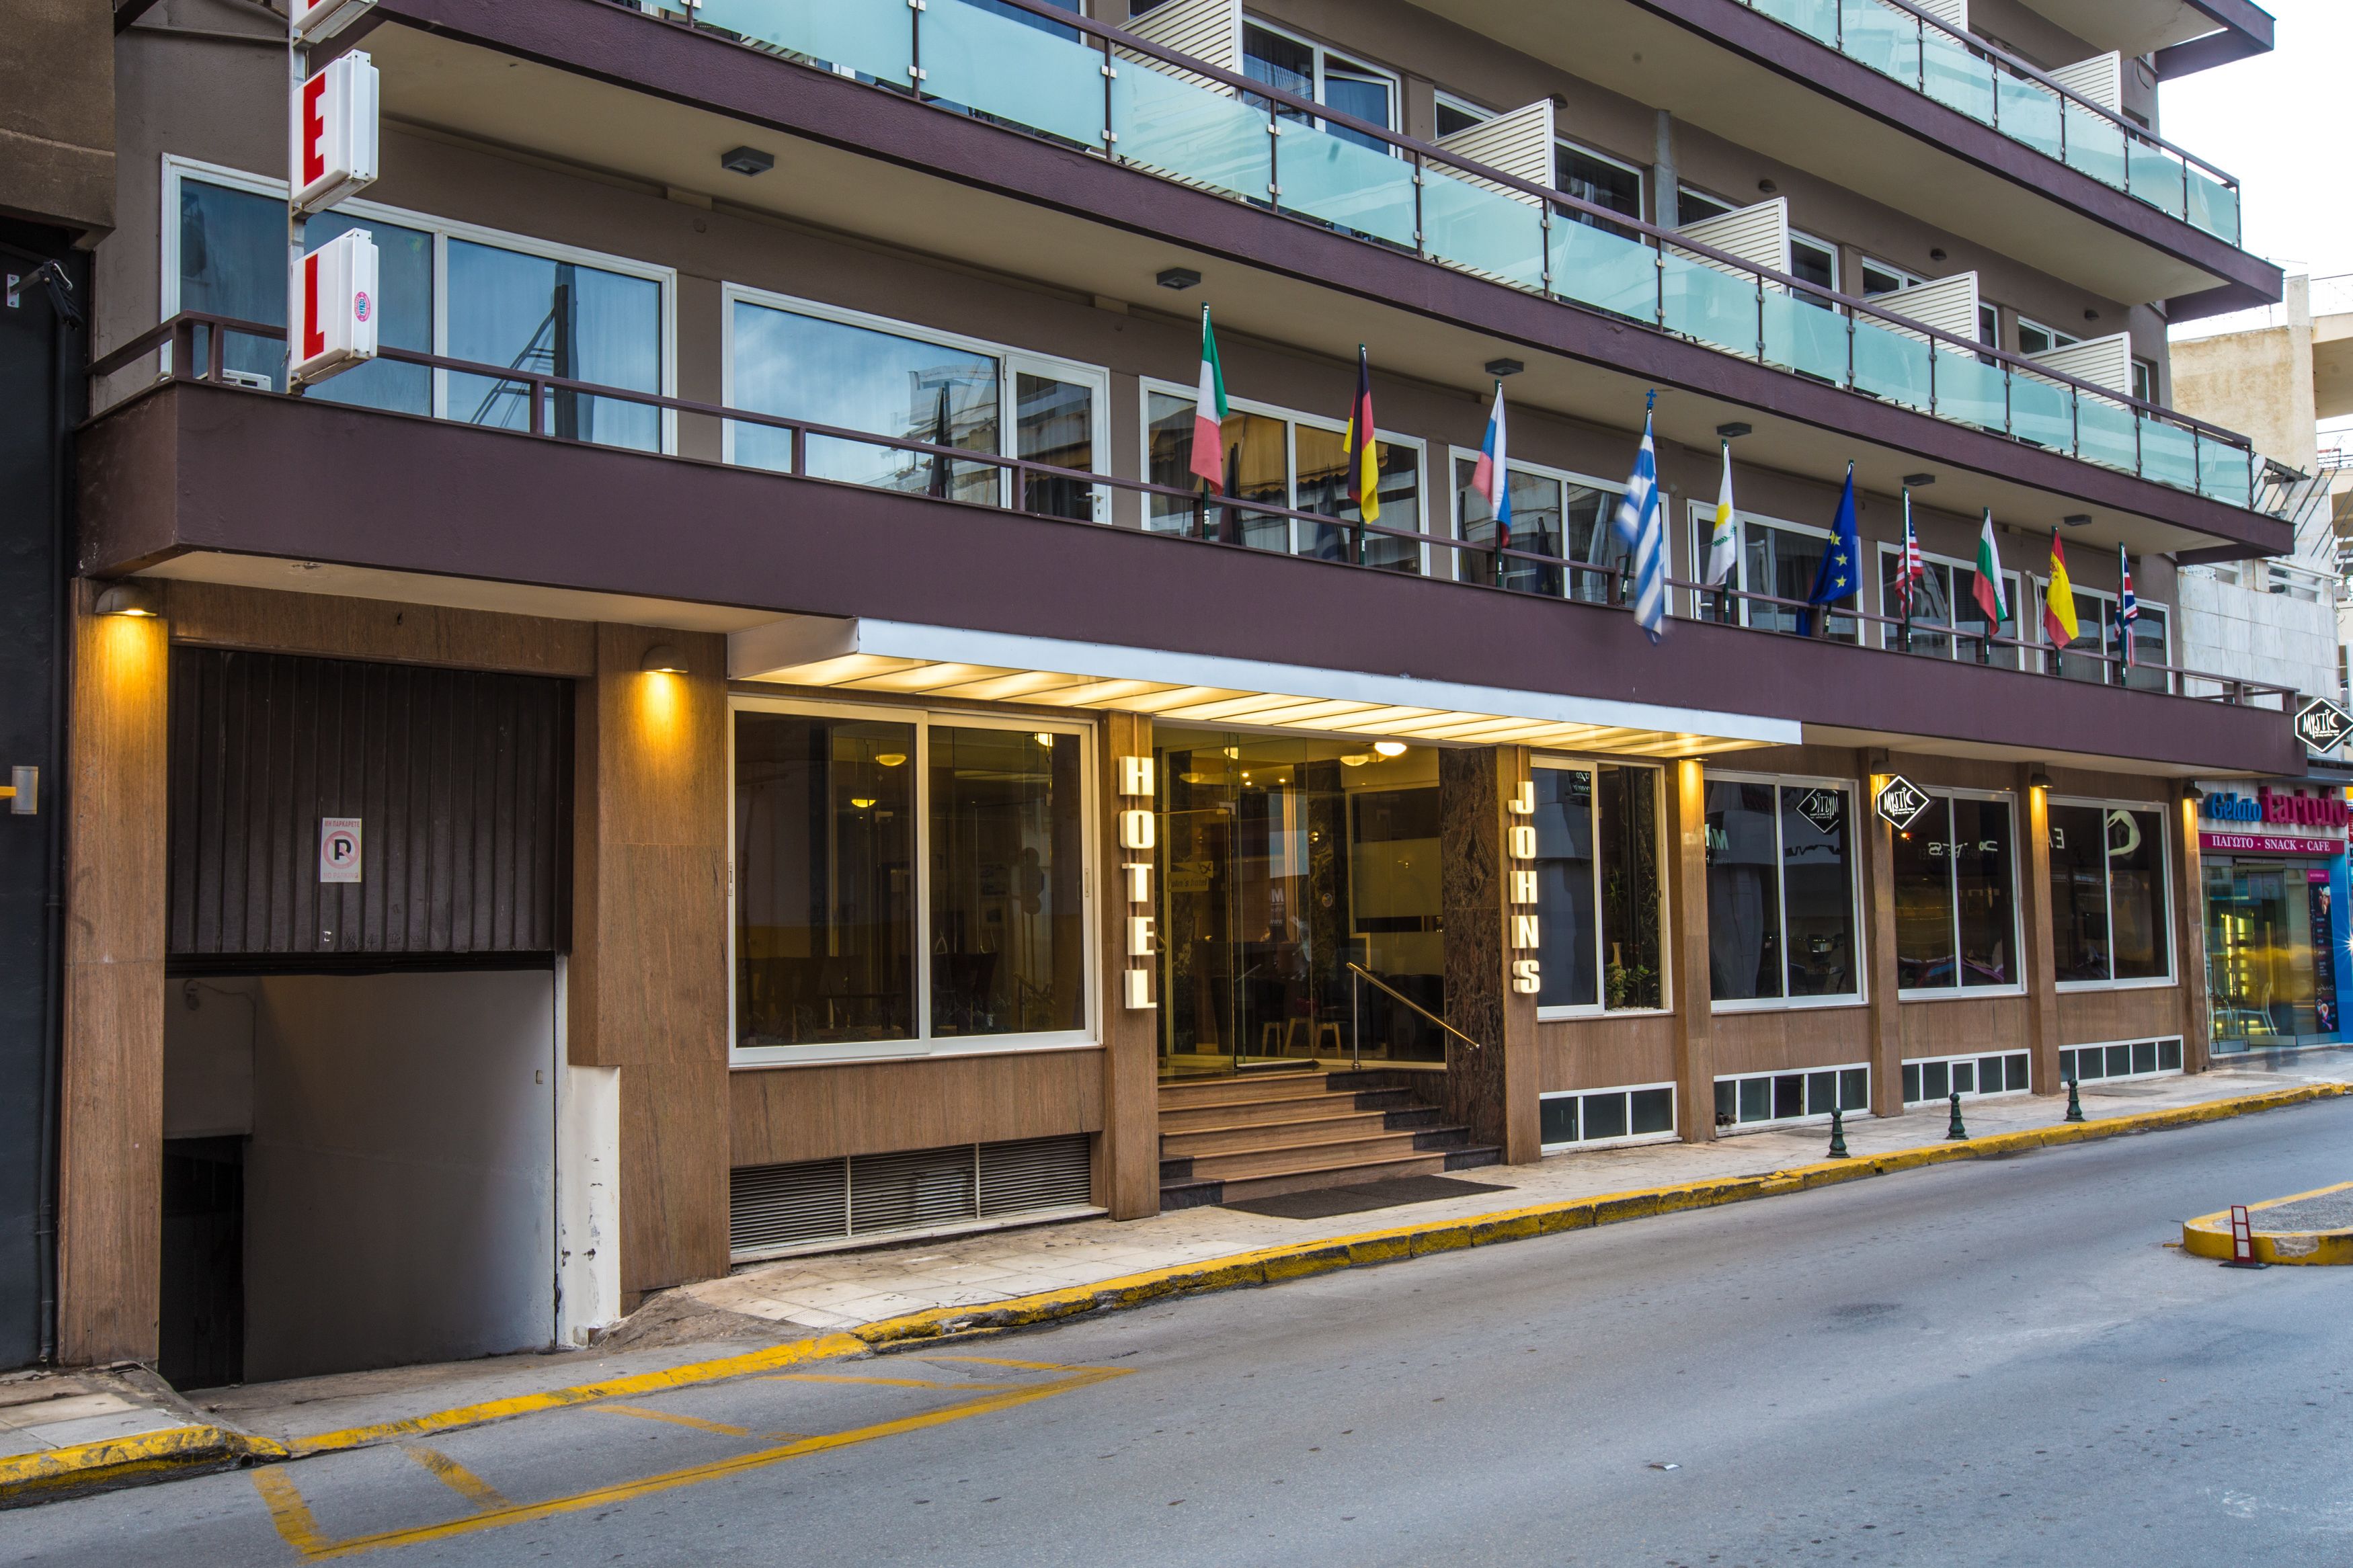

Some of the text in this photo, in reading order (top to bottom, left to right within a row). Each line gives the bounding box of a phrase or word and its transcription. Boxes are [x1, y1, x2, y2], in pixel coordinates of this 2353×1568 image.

[2204, 785, 2348, 828] Gelato tartufo
[2212, 835, 2254, 848] ΠΑΓΩΤΟ
[2265, 839, 2297, 851] SNACK
[2307, 840, 2331, 852] CAFE
[1119, 756, 1157, 1009] HOTEL
[1509, 781, 1540, 993] JOHNS
